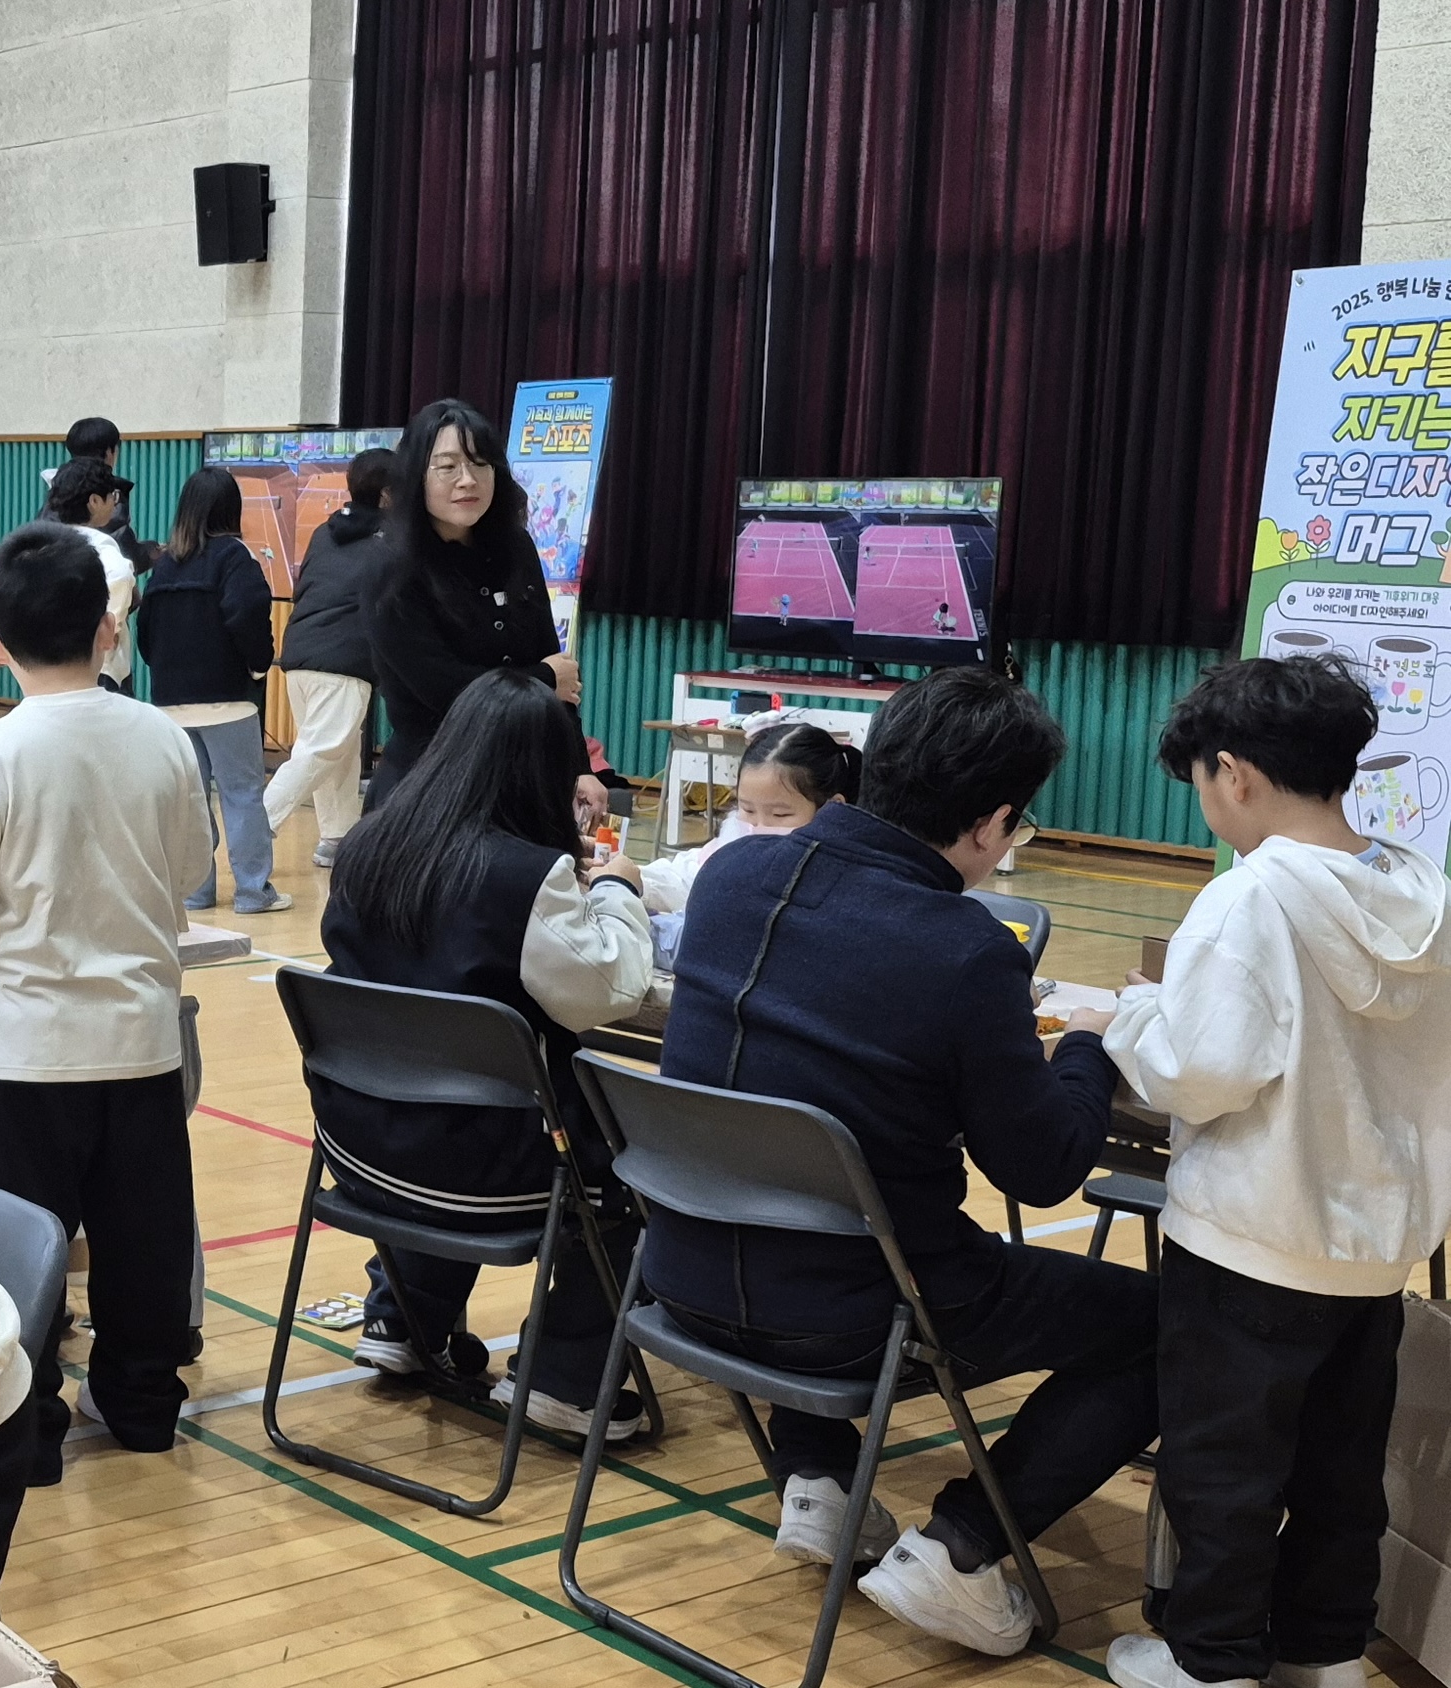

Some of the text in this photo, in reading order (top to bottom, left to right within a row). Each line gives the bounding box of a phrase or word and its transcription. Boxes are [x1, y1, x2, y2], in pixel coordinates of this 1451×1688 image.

[1331, 288, 1374, 321] 2025.
[1376, 277, 1408, 302] 행복
[1412, 276, 1442, 299] 나눔
[520, 424, 593, 454] E-스포츠
[1332, 391, 1451, 451] 지키는
[1334, 513, 1432, 568] 머그
[1305, 586, 1440, 605] 나와 우리를 지키는 기후위기 대응
[1313, 604, 1429, 619] 아이디어를 디자인해주세요!
